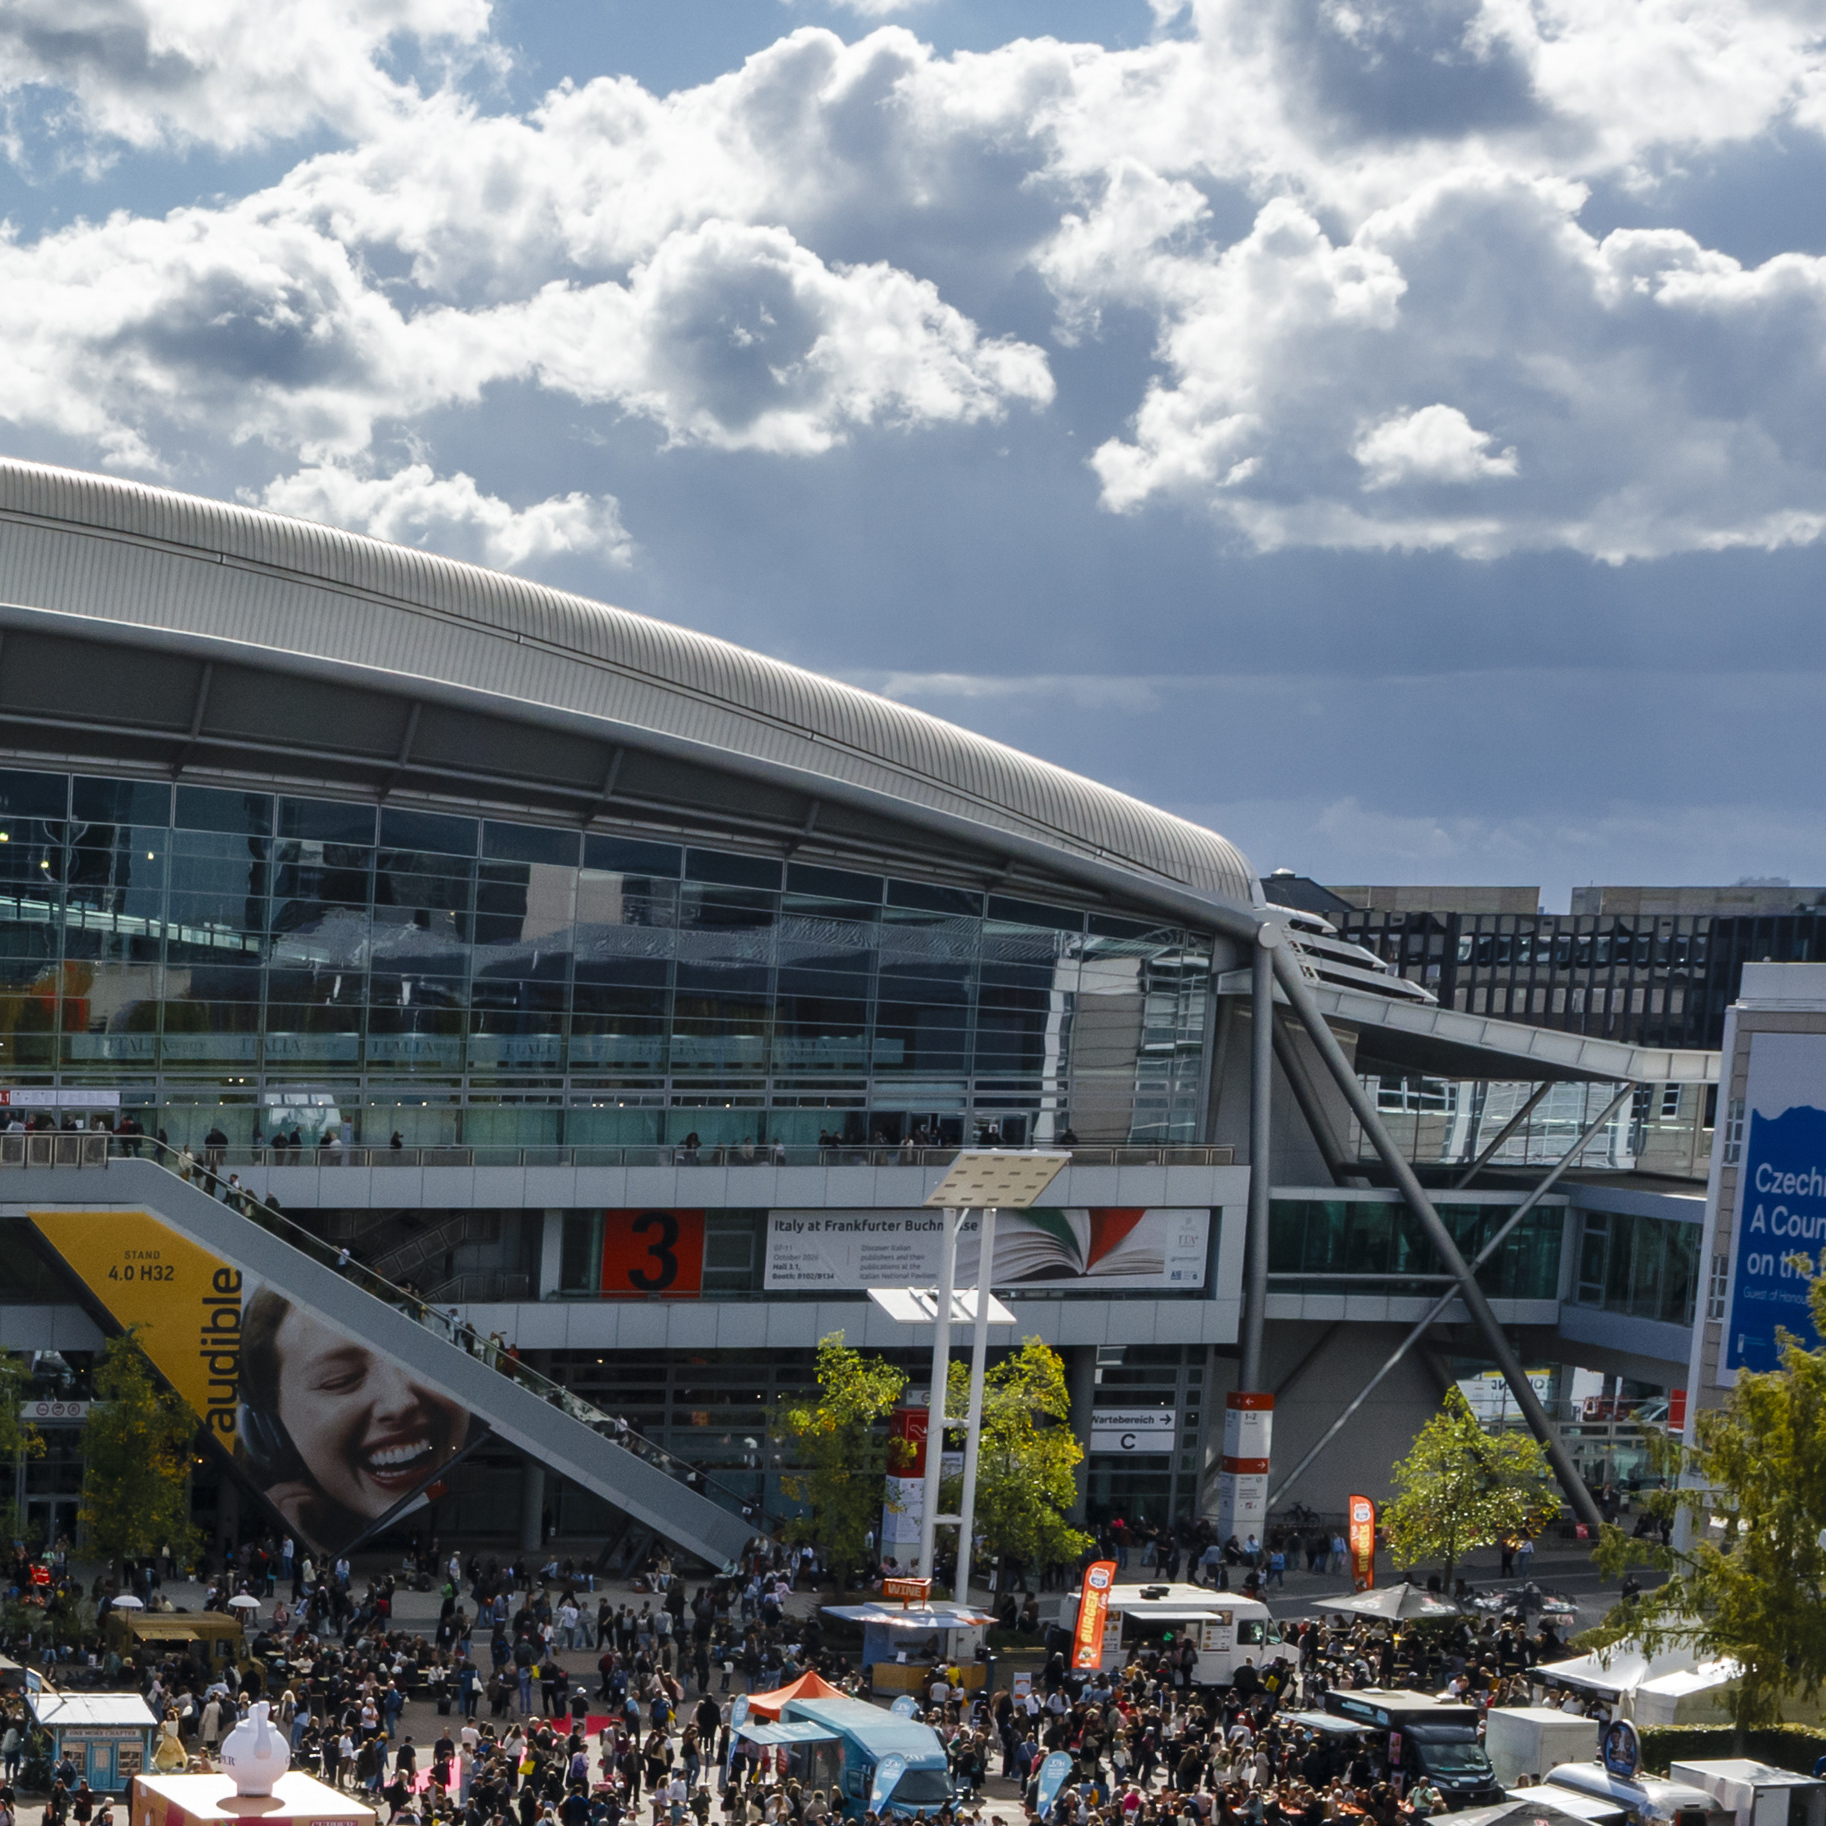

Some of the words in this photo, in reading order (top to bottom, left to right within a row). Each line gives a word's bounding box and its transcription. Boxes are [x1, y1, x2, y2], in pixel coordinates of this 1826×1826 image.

[774, 1219, 804, 1234] Italy
[807, 1221, 821, 1232] at
[824, 1219, 901, 1232] Frankfurter
[1749, 1203, 1766, 1234] A
[124, 1250, 161, 1260] STAND
[627, 1212, 680, 1293] 3
[1747, 1252, 1774, 1276] on
[108, 1265, 135, 1281] 4.0
[140, 1265, 175, 1281] H32
[200, 1267, 243, 1434] audible
[1120, 1433, 1137, 1450] C
[887, 1583, 923, 1598] WINE
[1080, 1589, 1100, 1643] BURGER
[106, 1729, 139, 1737] CHAPTER
